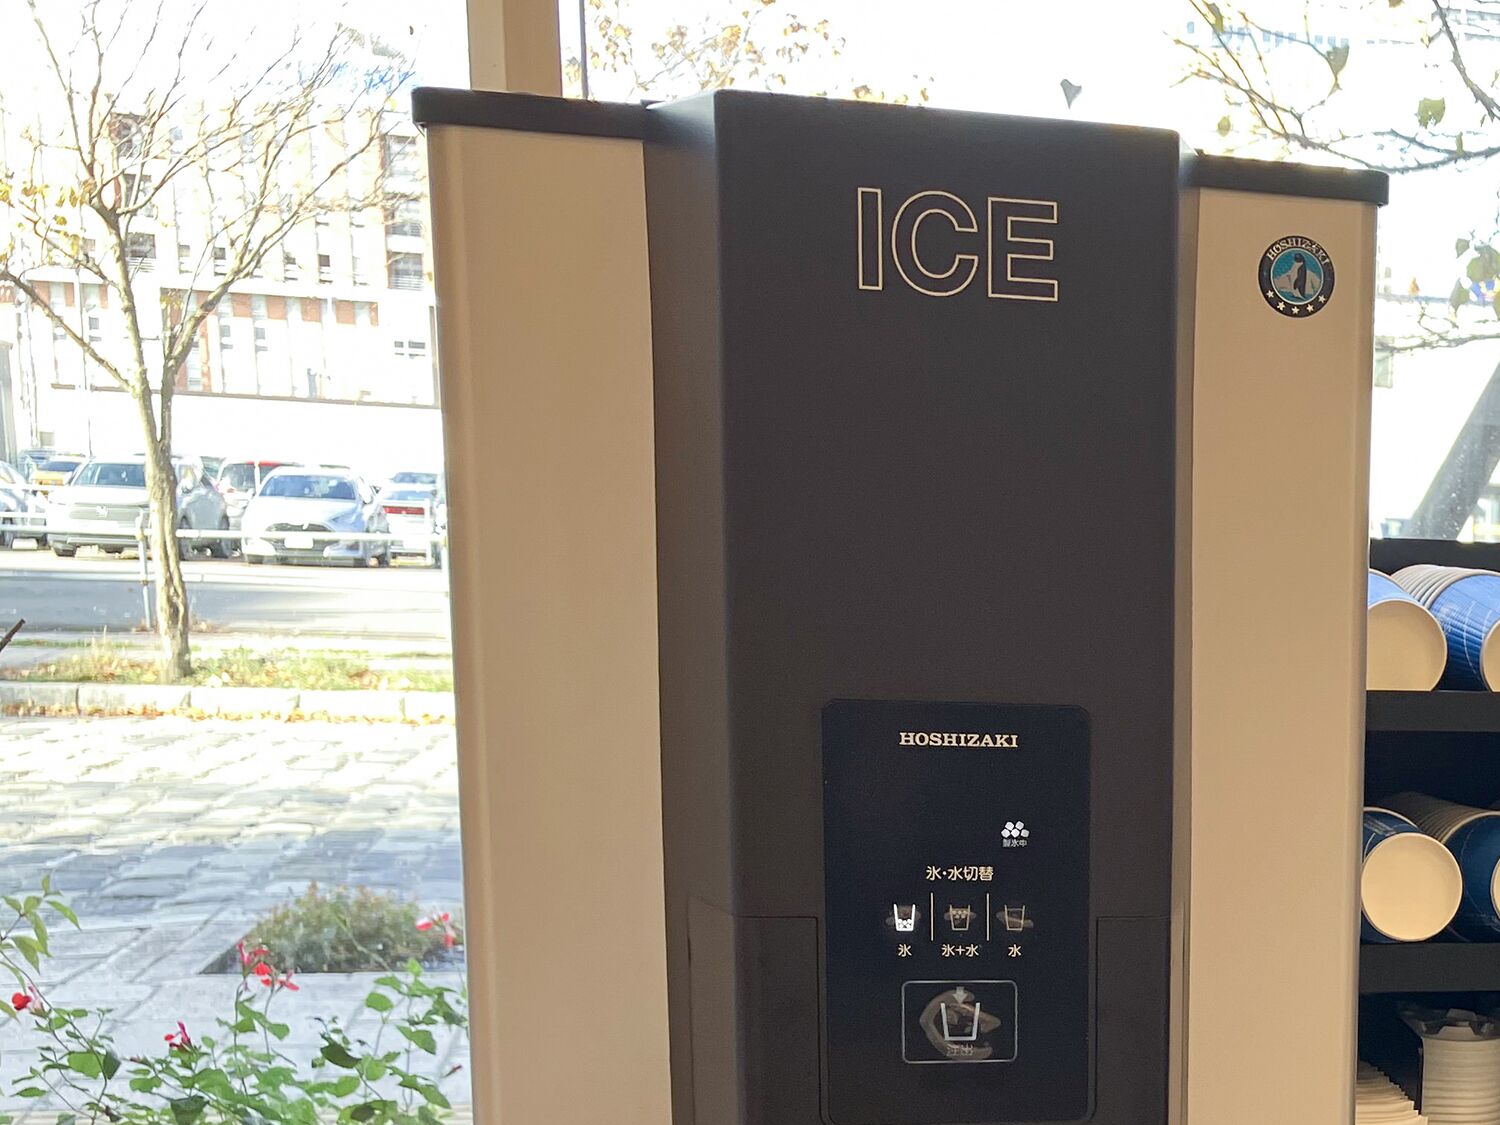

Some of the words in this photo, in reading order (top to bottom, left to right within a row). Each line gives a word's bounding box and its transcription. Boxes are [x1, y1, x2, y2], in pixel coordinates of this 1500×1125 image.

[857, 186, 1059, 302] ICE
[1266, 237, 1330, 265] HOSHIZAKI
[899, 731, 1019, 749] HOSHIZAKI
[925, 865, 994, 882] 氷・水切替
[897, 943, 912, 958] 氷
[1008, 943, 1022, 958] 水
